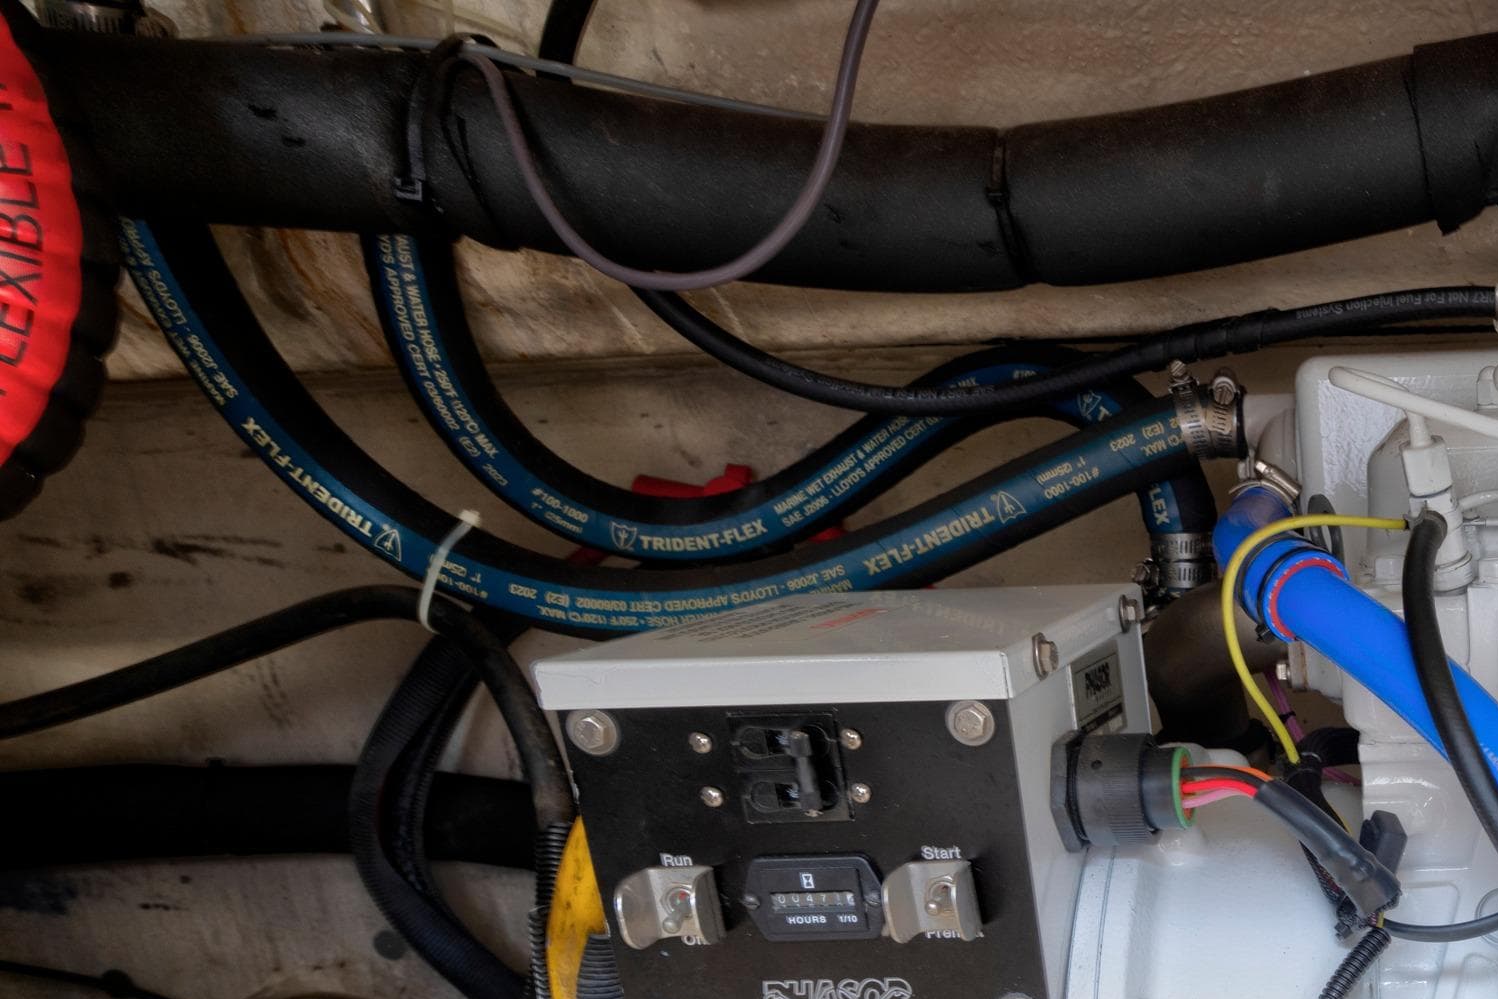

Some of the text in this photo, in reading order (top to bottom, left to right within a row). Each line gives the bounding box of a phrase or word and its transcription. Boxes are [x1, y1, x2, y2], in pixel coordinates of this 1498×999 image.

[1395, 293, 1423, 308] Fuel
[383, 265, 416, 342] APPROVED
[407, 343, 432, 379] CERT
[406, 286, 429, 329] WATER
[418, 329, 442, 363] HOSE
[1141, 421, 1165, 440] (E2)
[1109, 433, 1137, 452] 2023
[241, 416, 372, 538] TRIDENT-FLEX
[773, 488, 808, 515] MARINE
[805, 477, 826, 497] WET
[823, 453, 860, 485] EXHAUST
[861, 429, 891, 455] WATER
[780, 510, 804, 529] SAE
[831, 466, 868, 499] LLOYD'S
[863, 435, 908, 473] APPROVED
[904, 420, 931, 441] CERT
[1036, 461, 1073, 485] (25mm)
[1044, 467, 1101, 500] #100-1000
[639, 518, 768, 552] TRIDENT-FLEX
[864, 506, 996, 576] TRIDENT-FLEX
[822, 563, 847, 582] SAE
[631, 598, 663, 613] CERT
[664, 593, 729, 612] APPROVED
[646, 615, 679, 628] HOSE
[660, 853, 693, 867] Run
[921, 846, 962, 861] Start
[786, 914, 859, 925] HOURS 1/10
